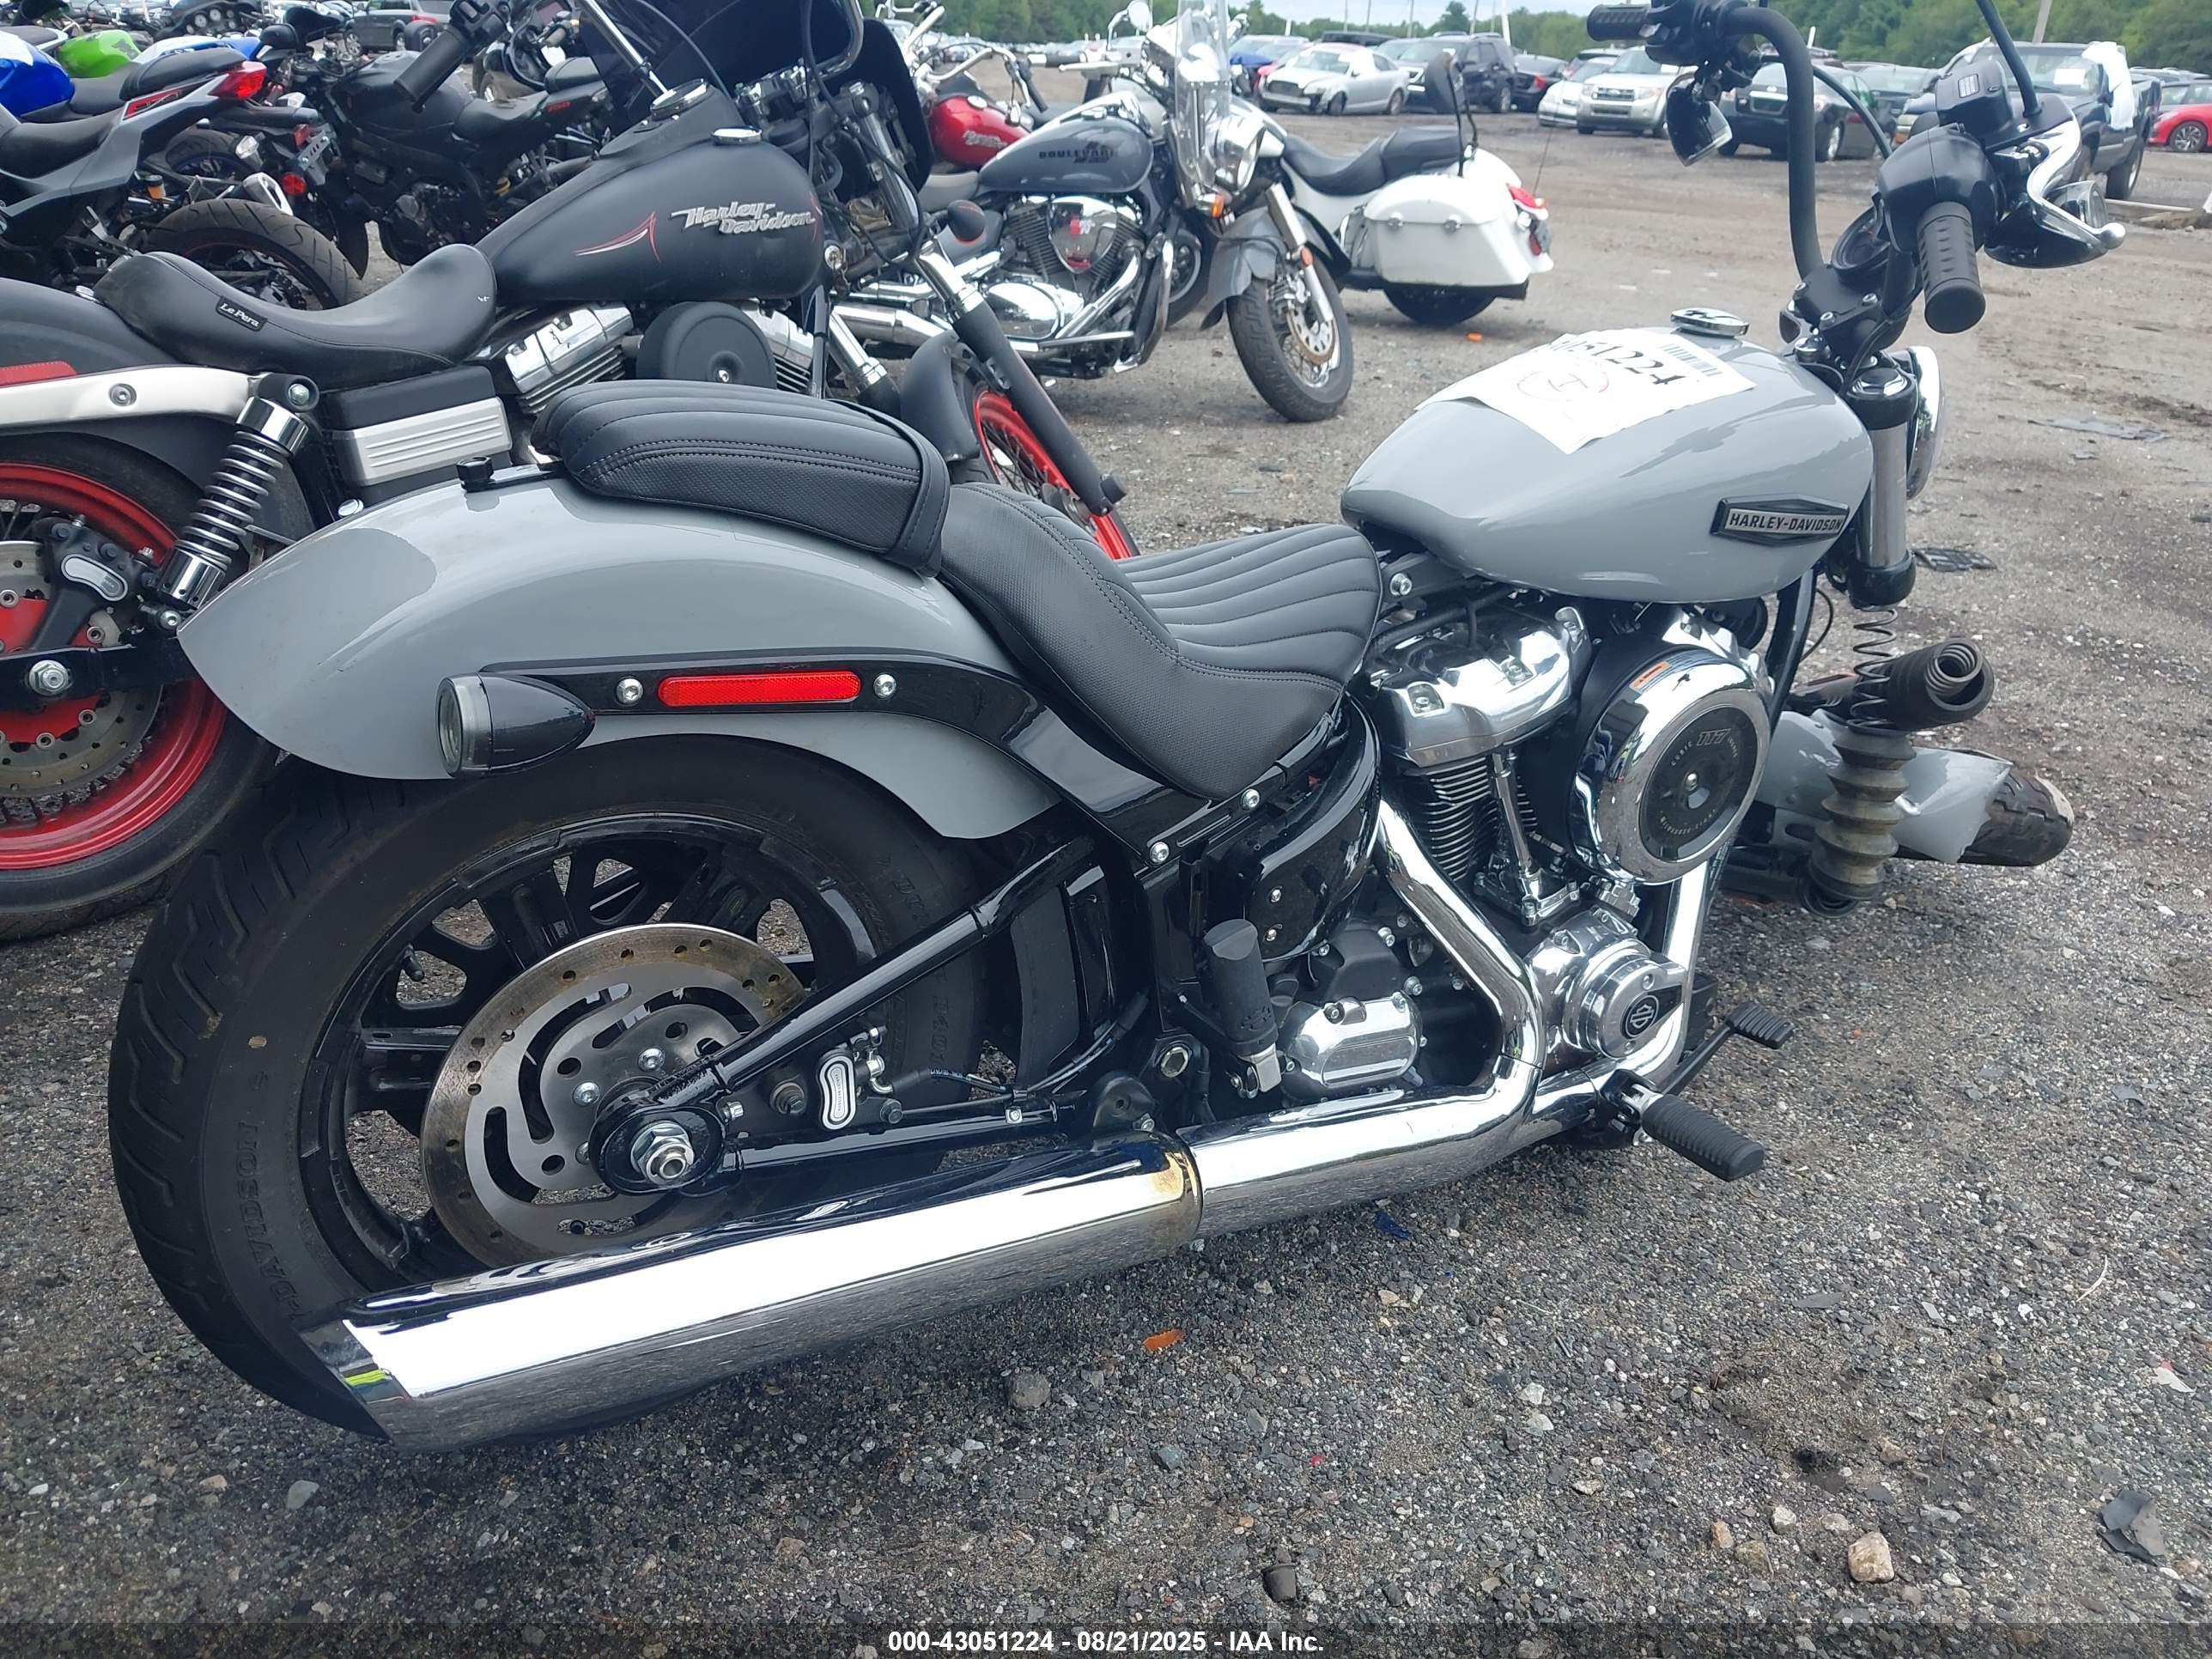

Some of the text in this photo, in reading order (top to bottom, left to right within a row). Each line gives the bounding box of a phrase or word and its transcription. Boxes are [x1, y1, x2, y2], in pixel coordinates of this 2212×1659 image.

[220, 303, 259, 327] Le Pera
[1729, 513, 1842, 531] HARLEY-DAVIDSON
